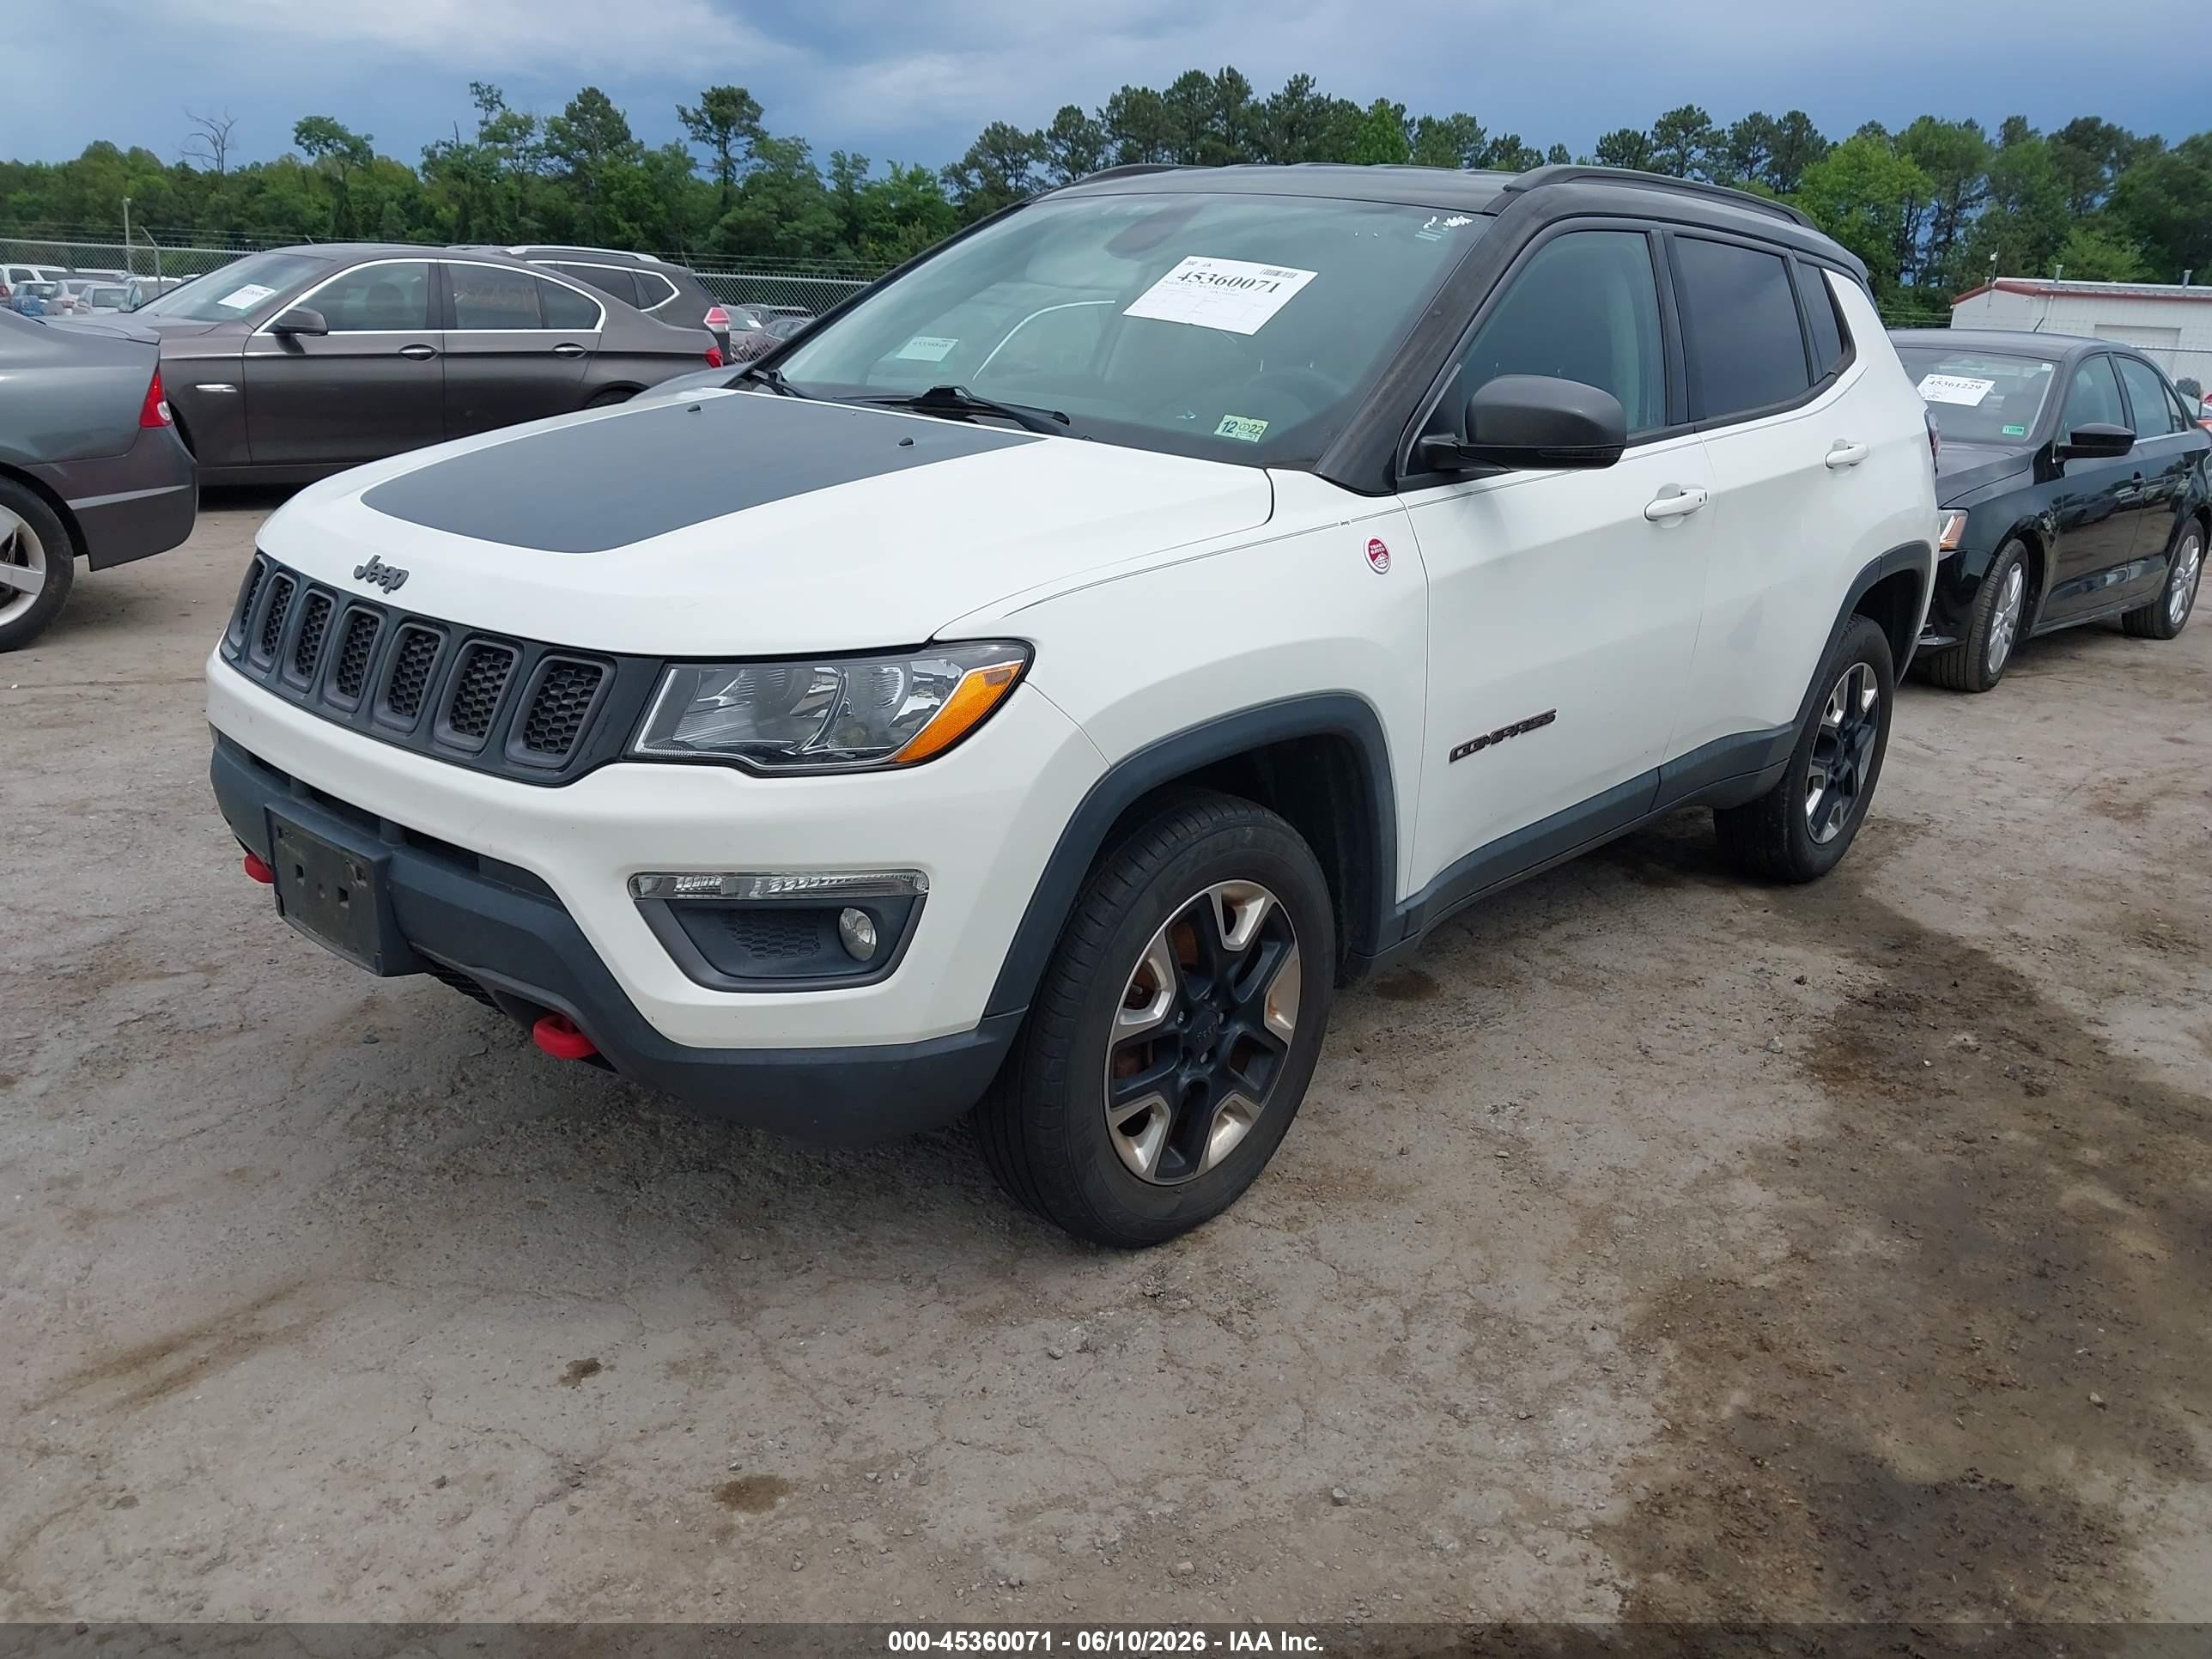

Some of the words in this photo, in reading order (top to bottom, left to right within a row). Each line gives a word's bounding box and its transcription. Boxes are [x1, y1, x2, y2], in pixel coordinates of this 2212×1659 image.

[1177, 270, 1282, 294] 45360071
[1223, 420, 1237, 433] 12
[1249, 424, 1264, 434] 22
[353, 555, 410, 594] Jeep
[1449, 708, 1557, 763] COMPASS
